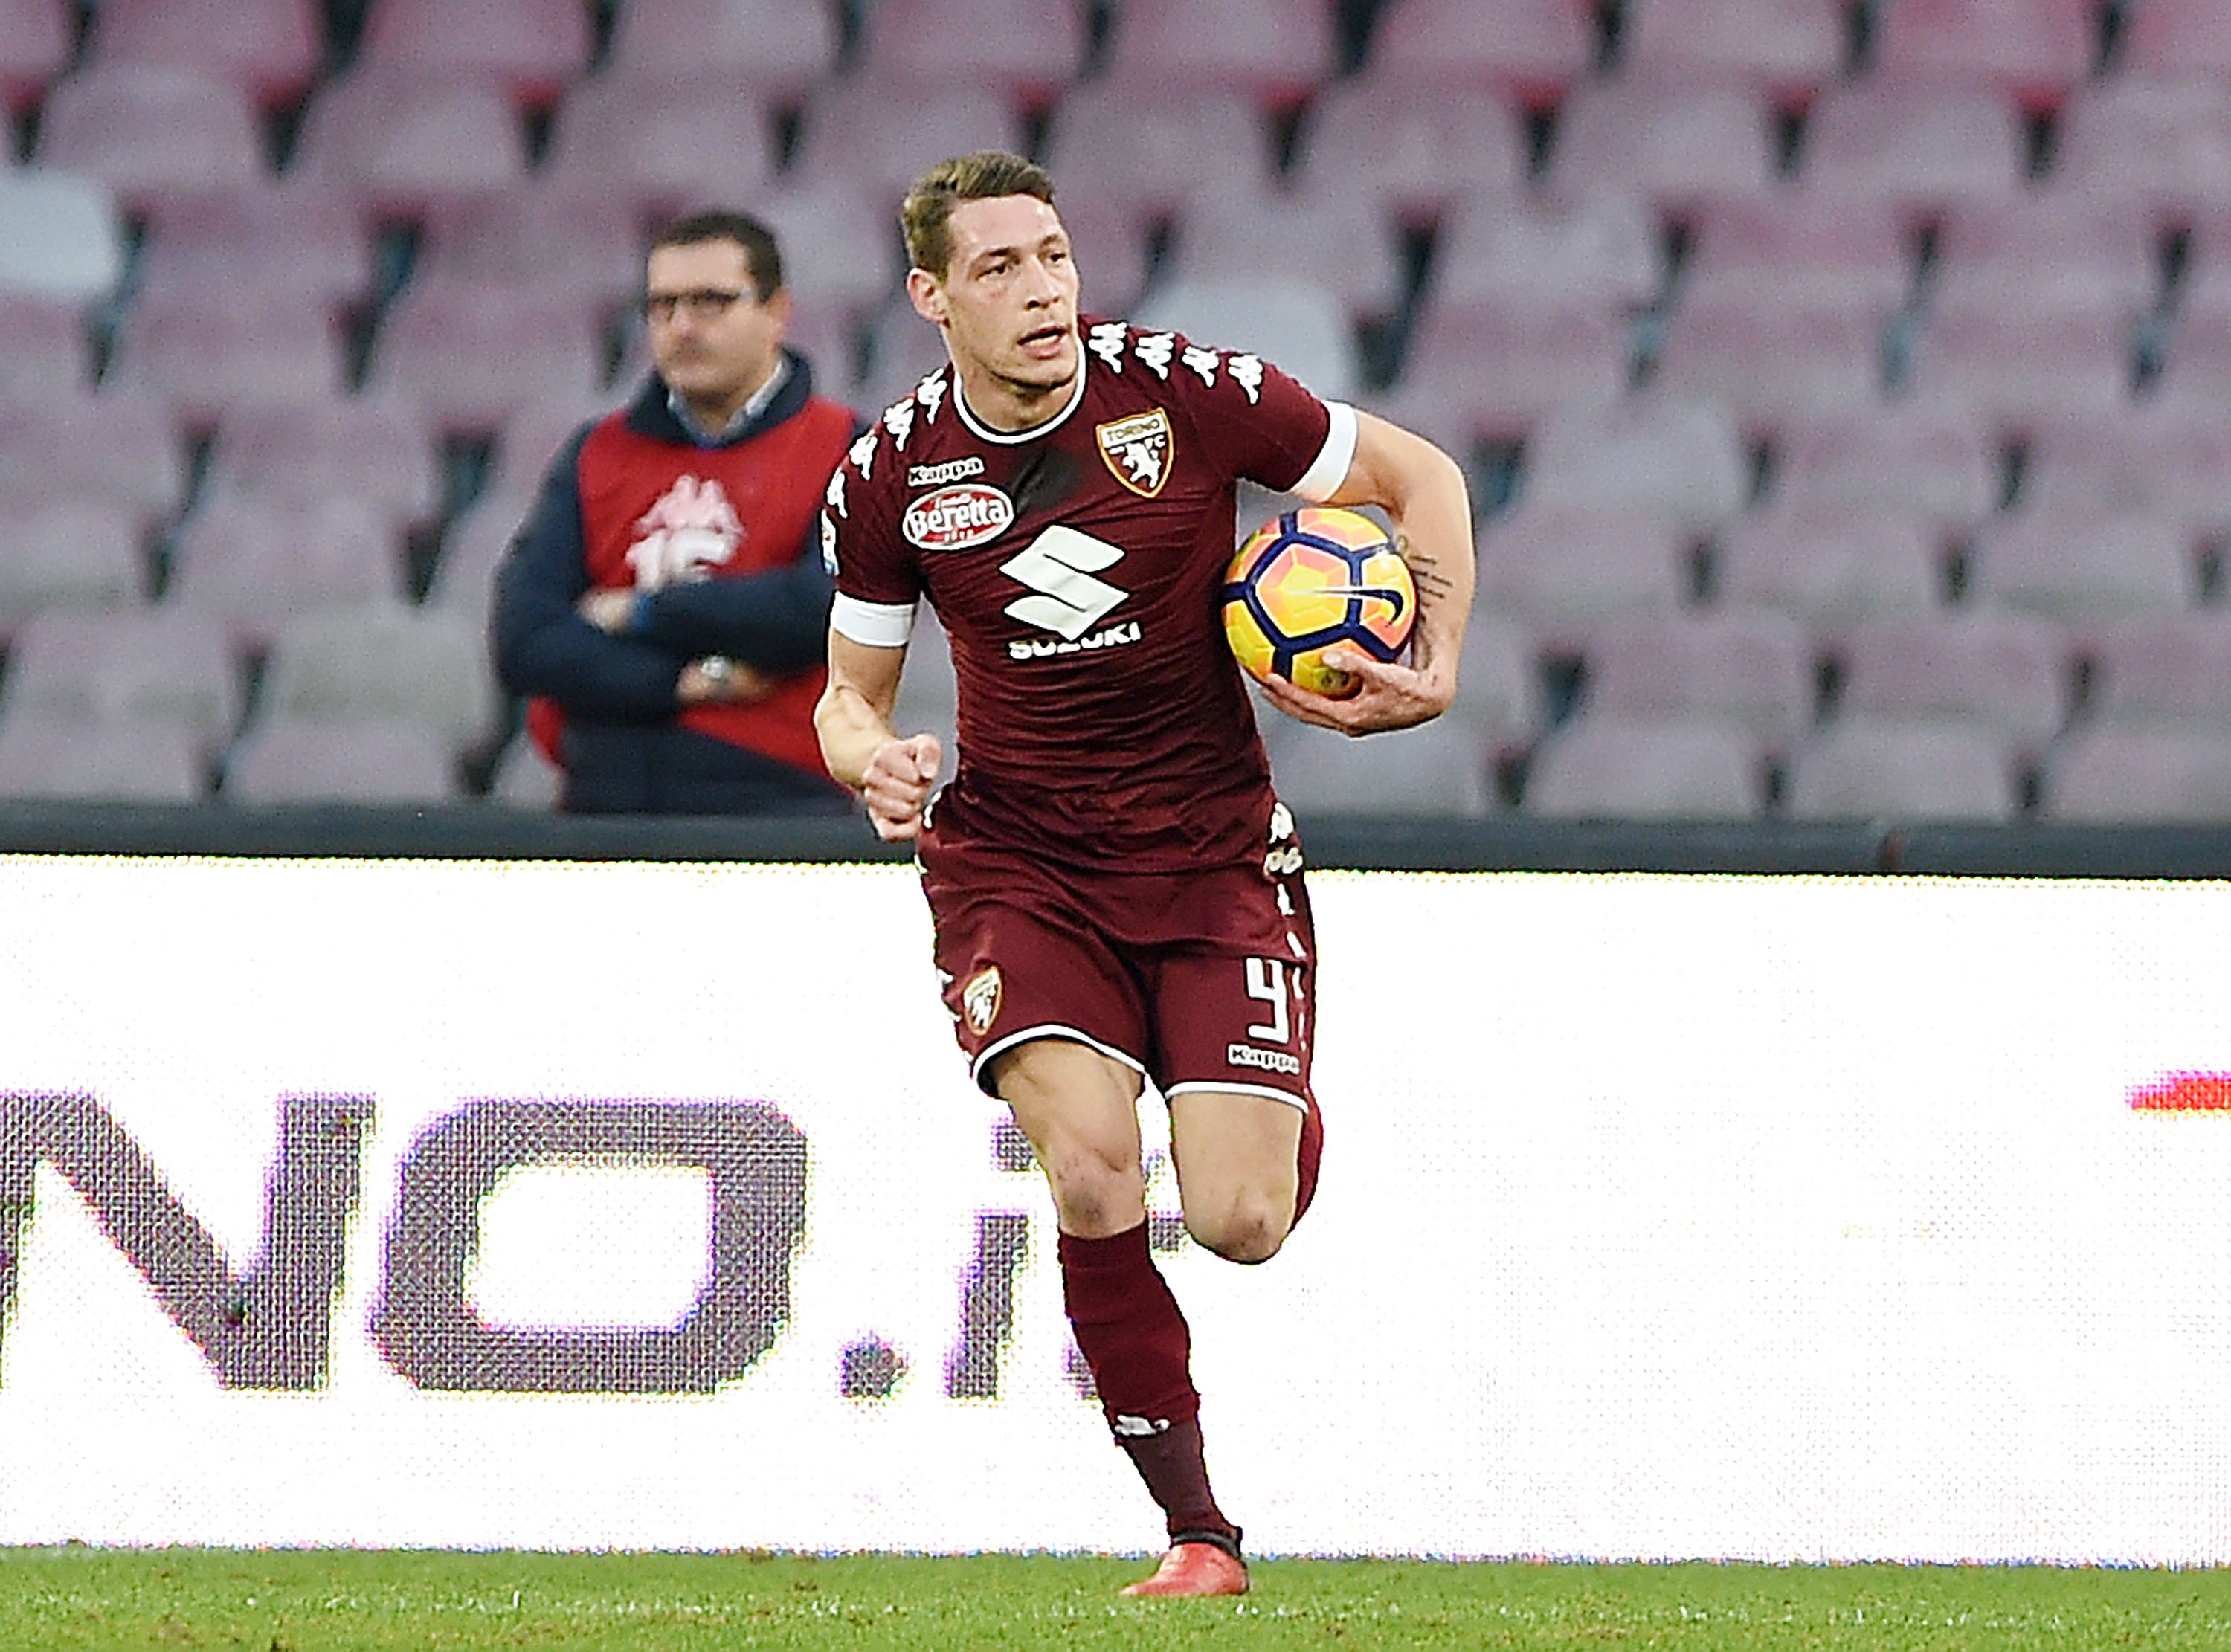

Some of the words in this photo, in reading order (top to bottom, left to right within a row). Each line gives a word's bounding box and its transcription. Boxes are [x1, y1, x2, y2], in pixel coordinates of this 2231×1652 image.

[1106, 418, 1160, 441] TORINO
[909, 458, 983, 485] Kappa
[910, 497, 1005, 538] Beretta
[1008, 622, 1142, 659] SUZUKI
[1246, 957, 1290, 1044] 9
[1229, 1045, 1300, 1074] Kappa
